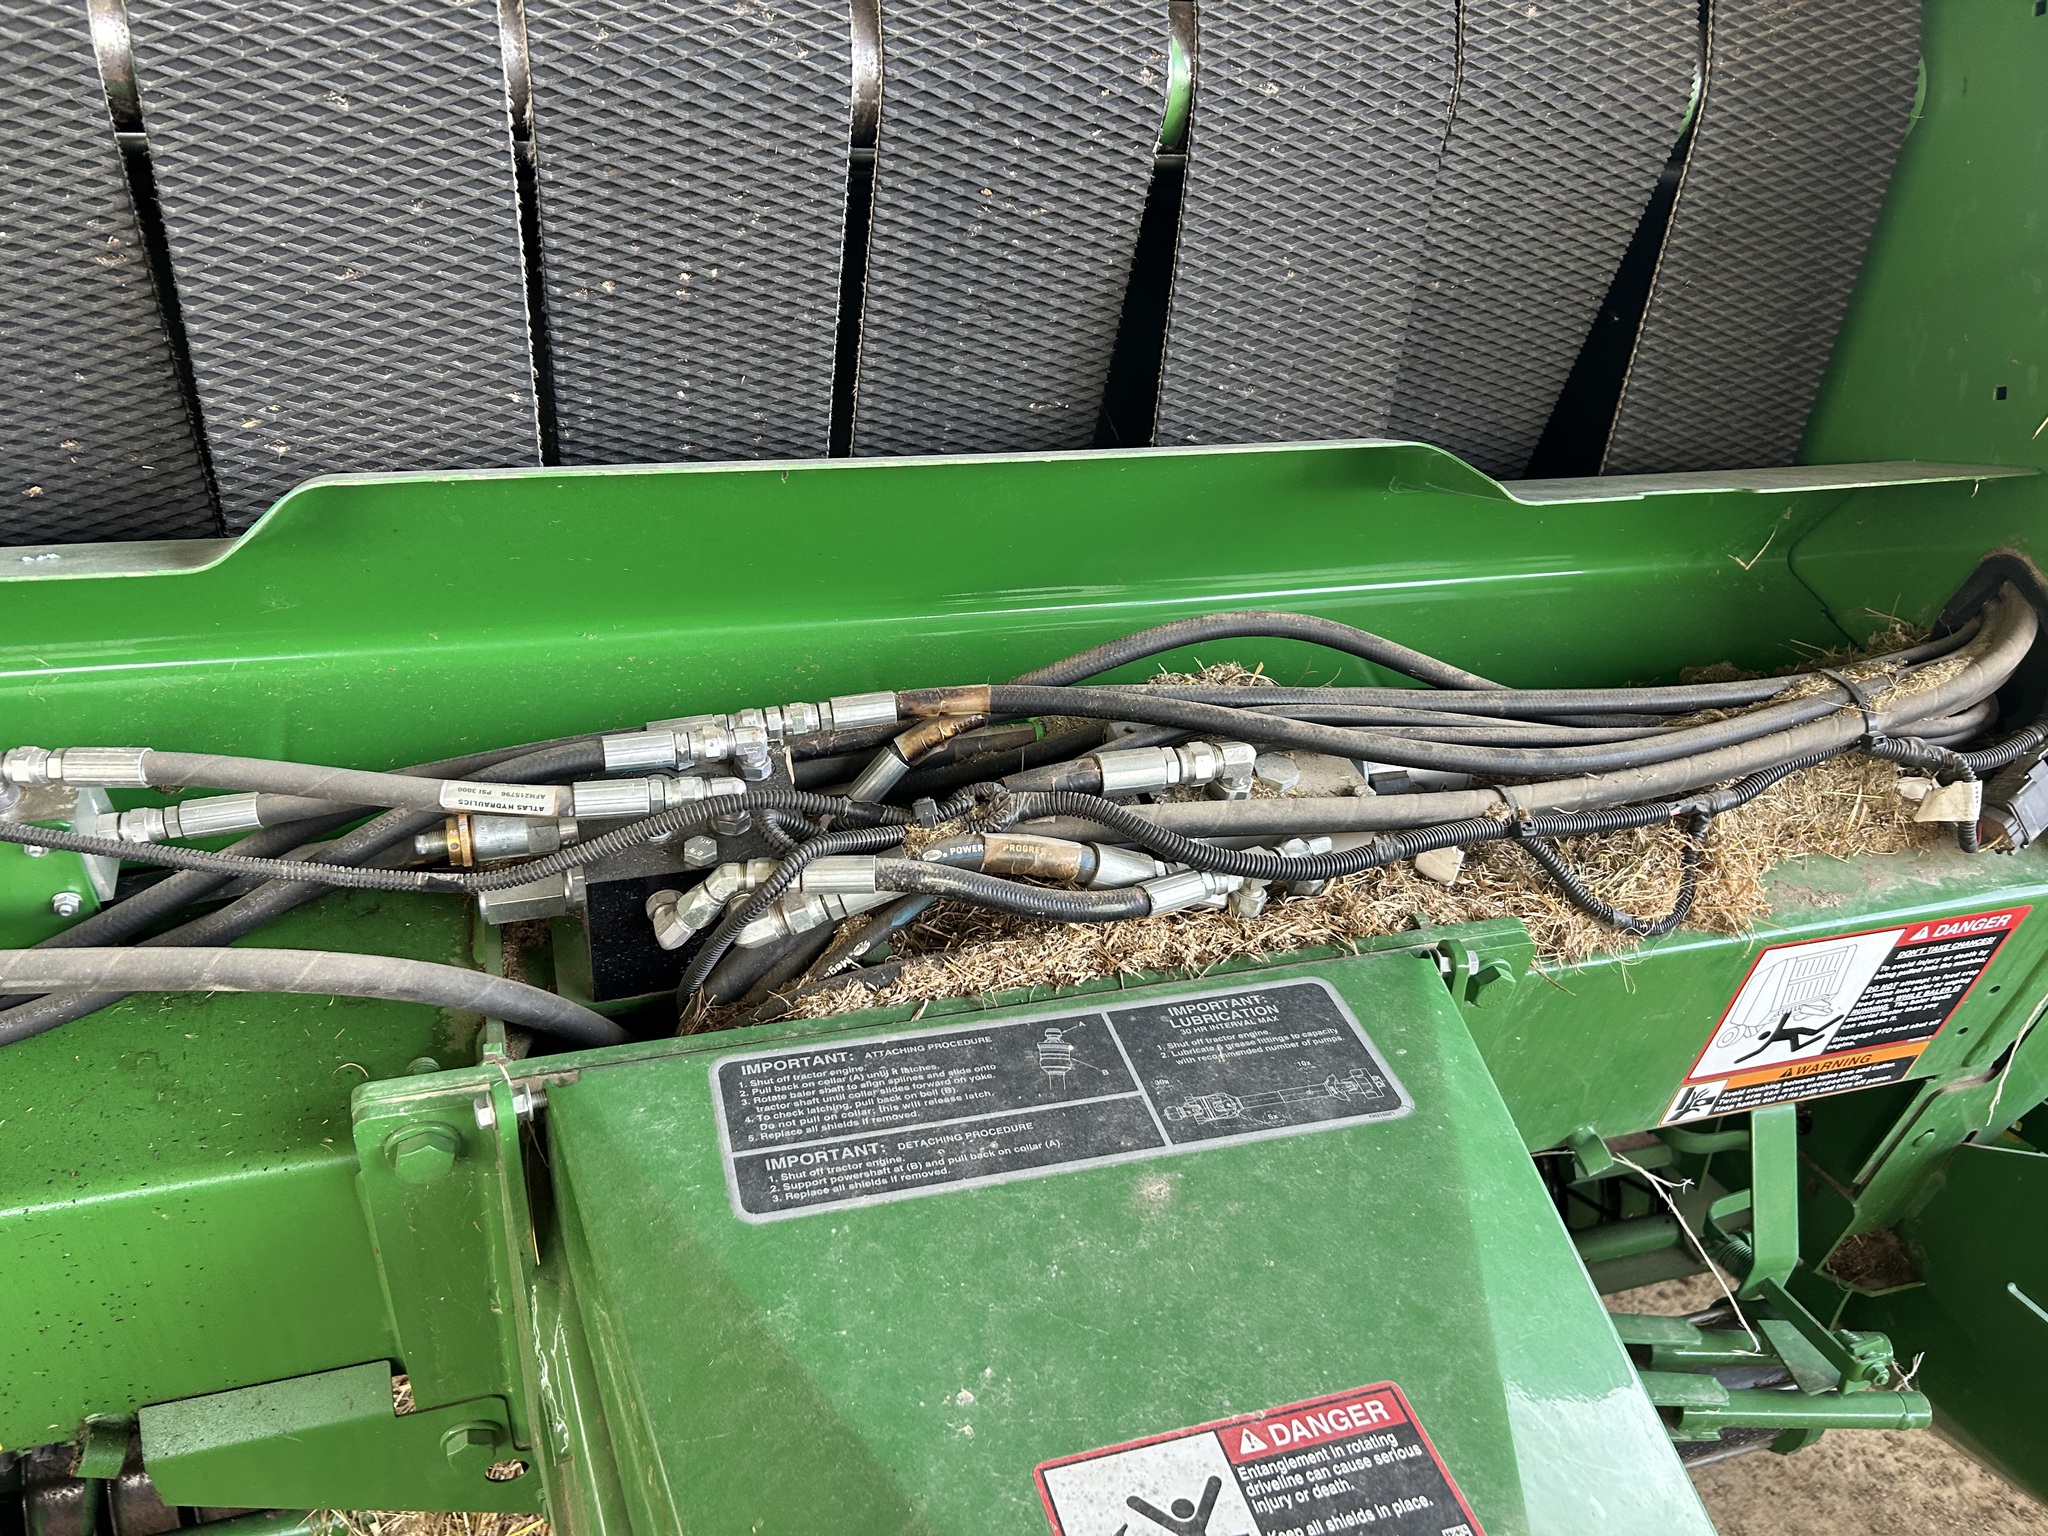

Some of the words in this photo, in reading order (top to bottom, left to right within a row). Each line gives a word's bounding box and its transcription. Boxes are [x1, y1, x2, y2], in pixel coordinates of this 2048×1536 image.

[458, 799, 514, 809] HYDRAULICS
[950, 843, 984, 856] POWER
[1932, 914, 2012, 938] DANGER
[1891, 960, 1914, 971] avoid
[1916, 957, 1940, 968] injury
[1954, 951, 1976, 960] death
[1979, 949, 1989, 957] by
[1899, 948, 1924, 958] DON'T
[1928, 944, 1951, 953] TAKE
[1952, 936, 1997, 950] CHANCES!
[1865, 985, 1880, 993] DO
[1882, 982, 1899, 991] NOT
[1899, 976, 1931, 989] attempt
[1942, 971, 1959, 980] feed
[1961, 969, 1980, 979] crop
[1168, 995, 1266, 1016] IMPORTANT:
[1169, 1004, 1279, 1028] LUBRICATION
[1078, 1020, 1086, 1028] A
[1209, 1018, 1256, 1031] INTERVAL
[1258, 1015, 1279, 1023] MAX
[1831, 1031, 1876, 1042] Disengage
[1875, 1027, 1892, 1035] PTO
[1908, 1022, 1929, 1030] shut
[1166, 1041, 1188, 1050] Shut
[1191, 1038, 1203, 1046] off
[1205, 1034, 1236, 1043] tractor
[1238, 1029, 1271, 1040] engine.
[1171, 1044, 1214, 1057] Lubricate
[1225, 1040, 1256, 1050] grease
[1258, 1033, 1289, 1044] fittings
[1302, 1027, 1338, 1038] capacity
[1176, 1057, 1196, 1065] with
[1265, 1041, 1299, 1052] number
[1302, 1038, 1311, 1046] of
[1312, 1035, 1345, 1045] pumps.
[1827, 1042, 1855, 1050] engine.
[741, 1052, 854, 1075] IMPORTANT:
[865, 1045, 925, 1058] ATTACHING
[928, 1036, 992, 1050] PROCEDURE
[1796, 1054, 1872, 1075] WARNING
[750, 1079, 774, 1087] Shut
[777, 1075, 790, 1083] off
[793, 1071, 827, 1080] tractor
[830, 1065, 867, 1076] engine.
[752, 1086, 771, 1095] Pull
[775, 1083, 799, 1092] back
[818, 1076, 846, 1085] collar
[849, 1074, 864, 1082] (A)
[901, 1064, 940, 1074] latches.
[754, 1094, 787, 1104] Rotate
[790, 1089, 815, 1099] baler
[819, 1084, 844, 1094] shaft
[861, 1079, 885, 1089] align
[888, 1074, 924, 1084] splines
[927, 1070, 945, 1079] and
[948, 1067, 971, 1076] slide
[1744, 1093, 1762, 1101] arm
[1782, 1085, 1805, 1095] move
[1806, 1074, 1863, 1089] unexpectedly.
[756, 1102, 790, 1113] tractor
[794, 1097, 820, 1107] shaft
[823, 1094, 845, 1103] until
[848, 1088, 876, 1099] collar
[880, 1085, 910, 1094] slides
[913, 1079, 951, 1089] forward
[969, 1073, 995, 1083] yoke.
[773, 1108, 804, 1118] check
[807, 1103, 852, 1116] latching,
[855, 1099, 874, 1108] pull
[877, 1094, 901, 1104] back
[920, 1089, 938, 1097] bell
[941, 1087, 958, 1096] (B).
[760, 1128, 802, 1140] Replace
[806, 1125, 818, 1133] all
[821, 1117, 859, 1130] shields
[862, 1116, 868, 1124] if
[872, 1111, 920, 1123] removed.
[765, 1142, 885, 1171] IMPORTANT:
[897, 1134, 963, 1150] DETACHING
[966, 1122, 1033, 1140] PROCEDURE
[781, 1171, 806, 1181] Shut
[809, 1167, 823, 1176] off
[826, 1162, 862, 1174] tractor
[866, 1156, 905, 1167] engine.
[782, 1178, 827, 1190] Support
[830, 1168, 891, 1184] powershaft
[894, 1164, 903, 1172] at
[907, 1161, 922, 1172] (B)
[925, 1159, 945, 1168] and
[949, 1155, 967, 1166] pull
[970, 1151, 995, 1160] back
[998, 1147, 1012, 1156] on
[1013, 1142, 1043, 1152] collar
[1045, 1139, 1063, 1149] (A).
[785, 1188, 829, 1200] Replace
[832, 1184, 845, 1192] all
[849, 1178, 888, 1190] shields
[901, 1167, 951, 1181] removed.
[1267, 1399, 1390, 1447] DANGER
[1237, 1445, 1331, 1482] Entanglement
[1331, 1444, 1344, 1456] in
[1346, 1432, 1398, 1453] rotating
[1245, 1472, 1304, 1497] driveline
[1305, 1466, 1331, 1483] can
[1333, 1455, 1372, 1475] cause
[1374, 1444, 1422, 1465] serious
[1253, 1493, 1293, 1514] injury
[1295, 1488, 1311, 1503] or
[1313, 1479, 1355, 1499] death.
[1306, 1519, 1324, 1536] all
[1325, 1509, 1376, 1530] shields
[1375, 1503, 1391, 1518] in
[1395, 1493, 1434, 1517] place.
